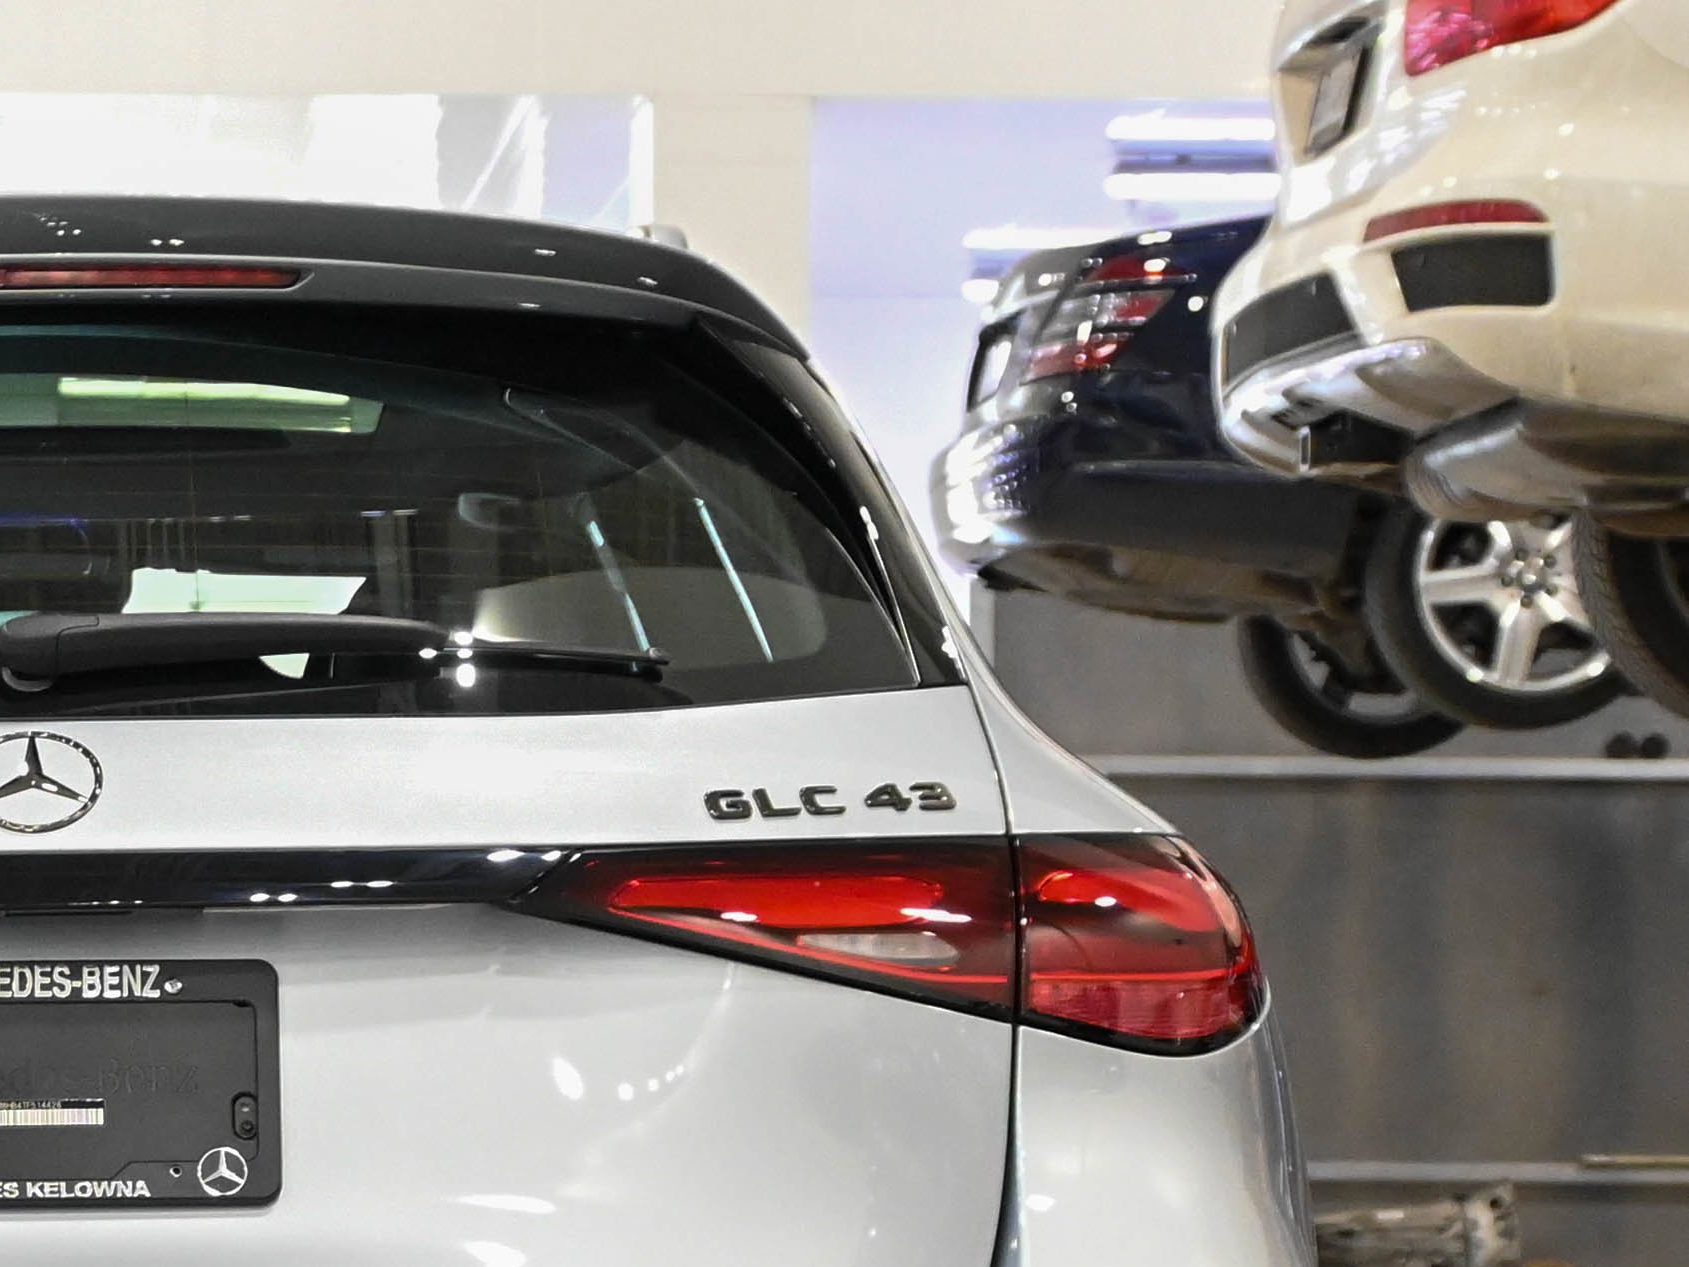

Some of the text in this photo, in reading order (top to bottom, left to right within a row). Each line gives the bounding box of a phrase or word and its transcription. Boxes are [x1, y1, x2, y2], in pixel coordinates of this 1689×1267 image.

[704, 780, 958, 820] GLC 43
[26, 1180, 152, 1198] KELOWNA
